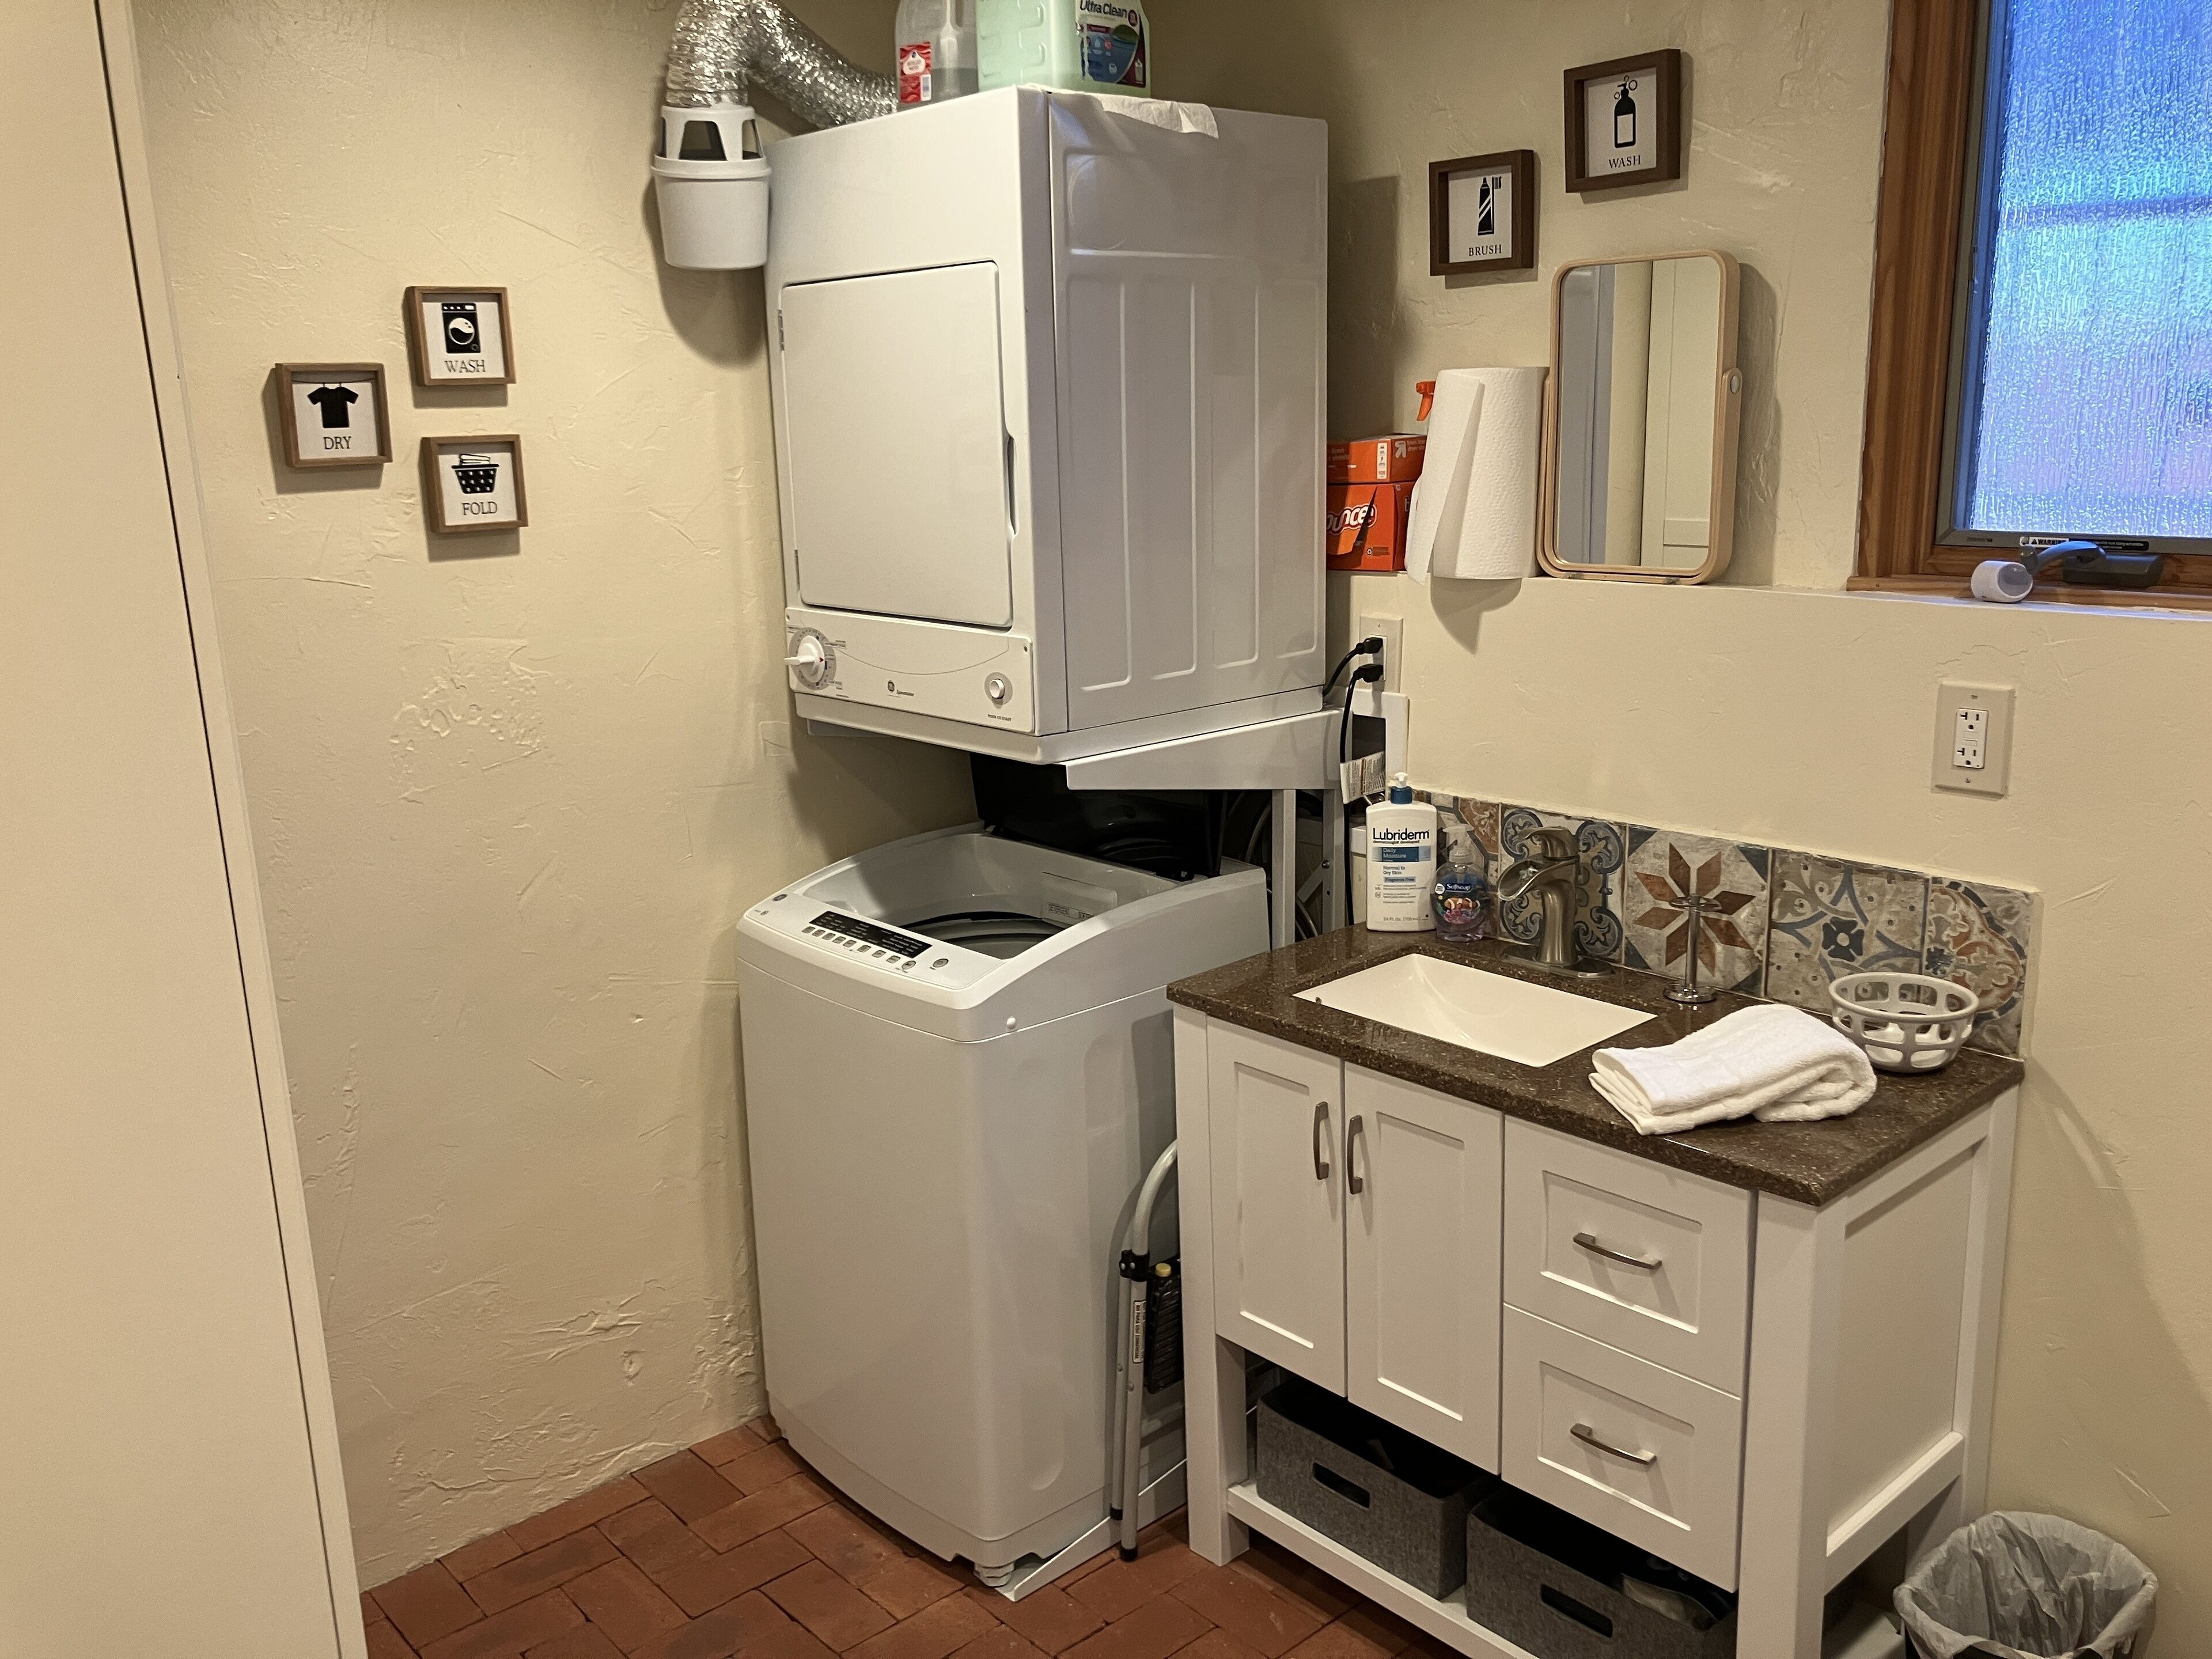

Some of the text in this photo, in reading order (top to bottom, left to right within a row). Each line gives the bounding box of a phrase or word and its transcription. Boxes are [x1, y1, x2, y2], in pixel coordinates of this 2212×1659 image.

[1609, 154, 1641, 169] WASH
[1468, 244, 1502, 257] BRUSH
[444, 359, 486, 373] WASH
[323, 436, 352, 450] DRY
[461, 501, 498, 516] FOLD
[1327, 506, 1374, 532] ounce
[1373, 827, 1430, 840] Lubriderm
[1446, 883, 1471, 891] Softsoap
